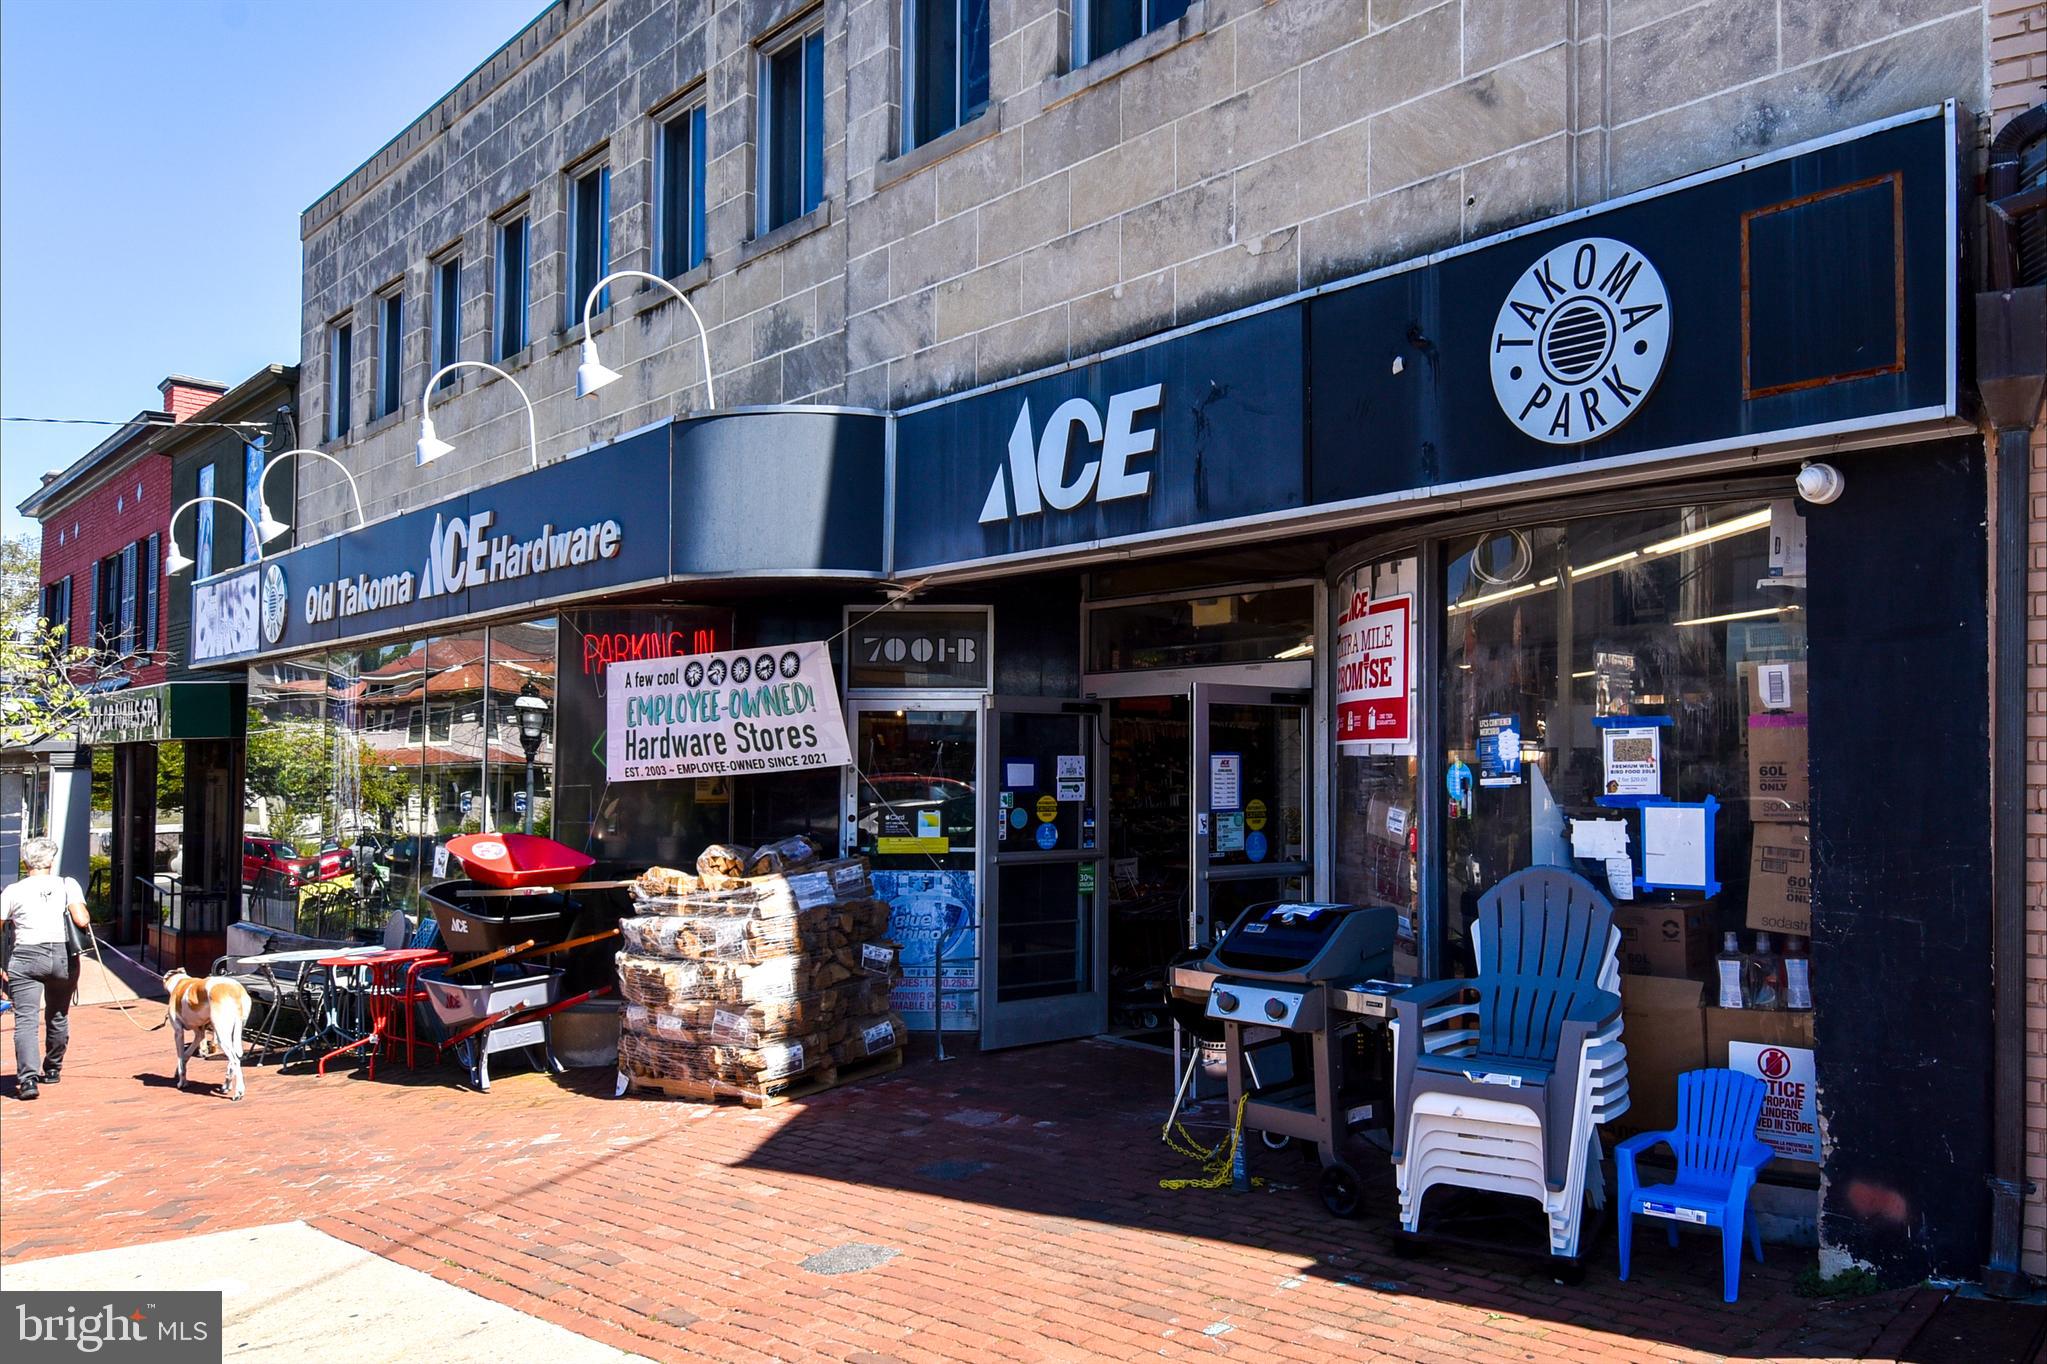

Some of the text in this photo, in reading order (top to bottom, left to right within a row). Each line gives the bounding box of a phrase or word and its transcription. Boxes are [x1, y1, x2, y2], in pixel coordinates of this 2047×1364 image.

[1496, 244, 1663, 353] TAKOMA
[1519, 363, 1642, 437] PARK
[978, 383, 1165, 523] ACE
[305, 582, 336, 624] Old
[338, 570, 415, 617] Takoma
[418, 511, 495, 599] ACE
[489, 519, 622, 582] Hardware
[1348, 591, 1369, 621] ACE
[864, 638, 976, 662] 7001-B
[1361, 624, 1393, 652] MILE
[583, 631, 686, 675] PARKING
[625, 667, 679, 689] A few cool
[626, 681, 817, 728] EMPLOYEE-OWNED!
[625, 721, 818, 761] Hardware Stores
[624, 766, 644, 778] EST.
[645, 765, 667, 777] 2003
[677, 758, 766, 776] EMPLOYEE-OWNED
[768, 755, 800, 768] SINCE
[802, 752, 828, 765] 2021
[1760, 766, 1787, 776] 60L
[1760, 783, 1788, 791] ONLY
[451, 917, 468, 933] ACE
[894, 912, 933, 927] Blue
[1774, 1118, 1783, 1130] IN
[1785, 1120, 1815, 1134] STORE.
